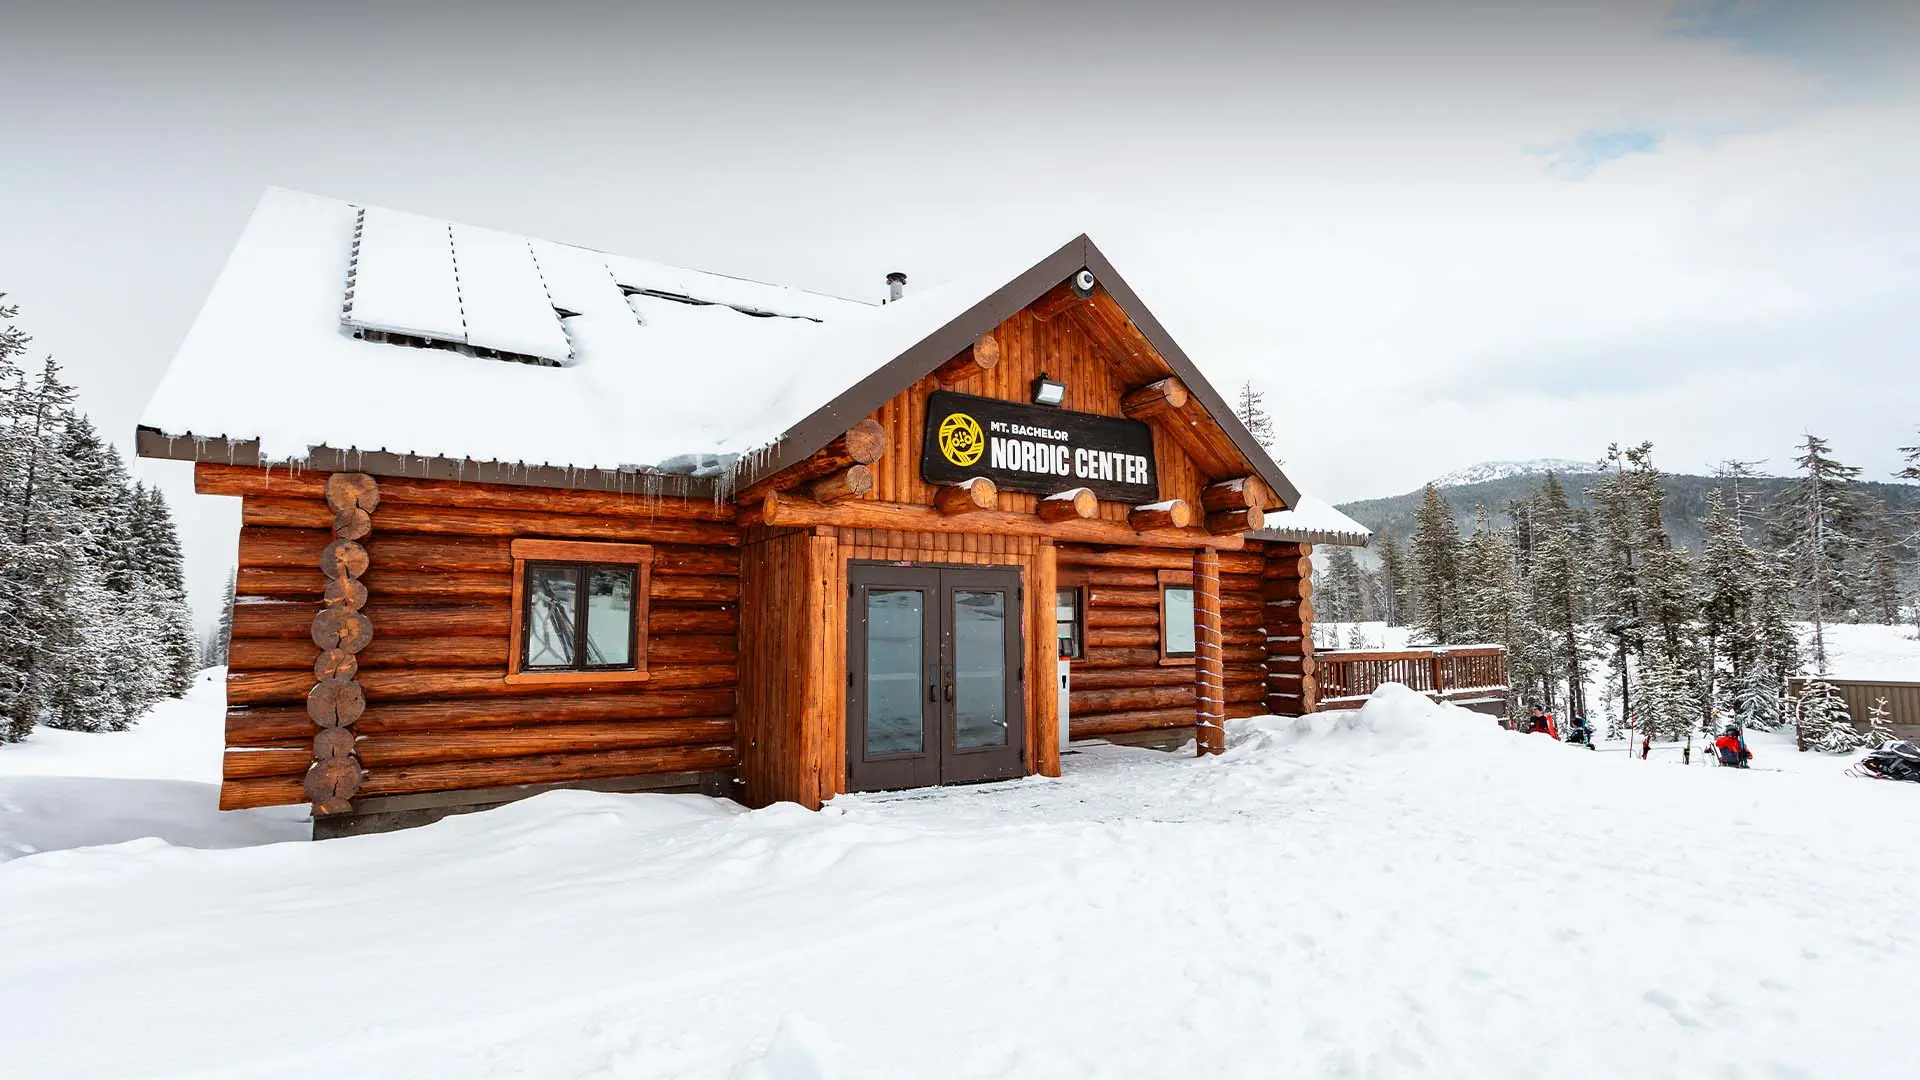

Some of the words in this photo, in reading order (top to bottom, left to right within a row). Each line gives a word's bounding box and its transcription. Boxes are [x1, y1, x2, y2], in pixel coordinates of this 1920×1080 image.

[990, 421, 1009, 434] MT.
[1012, 424, 1069, 441] BACHELOR
[991, 437, 1070, 477] NORDIC
[1075, 448, 1148, 485] CENTER
